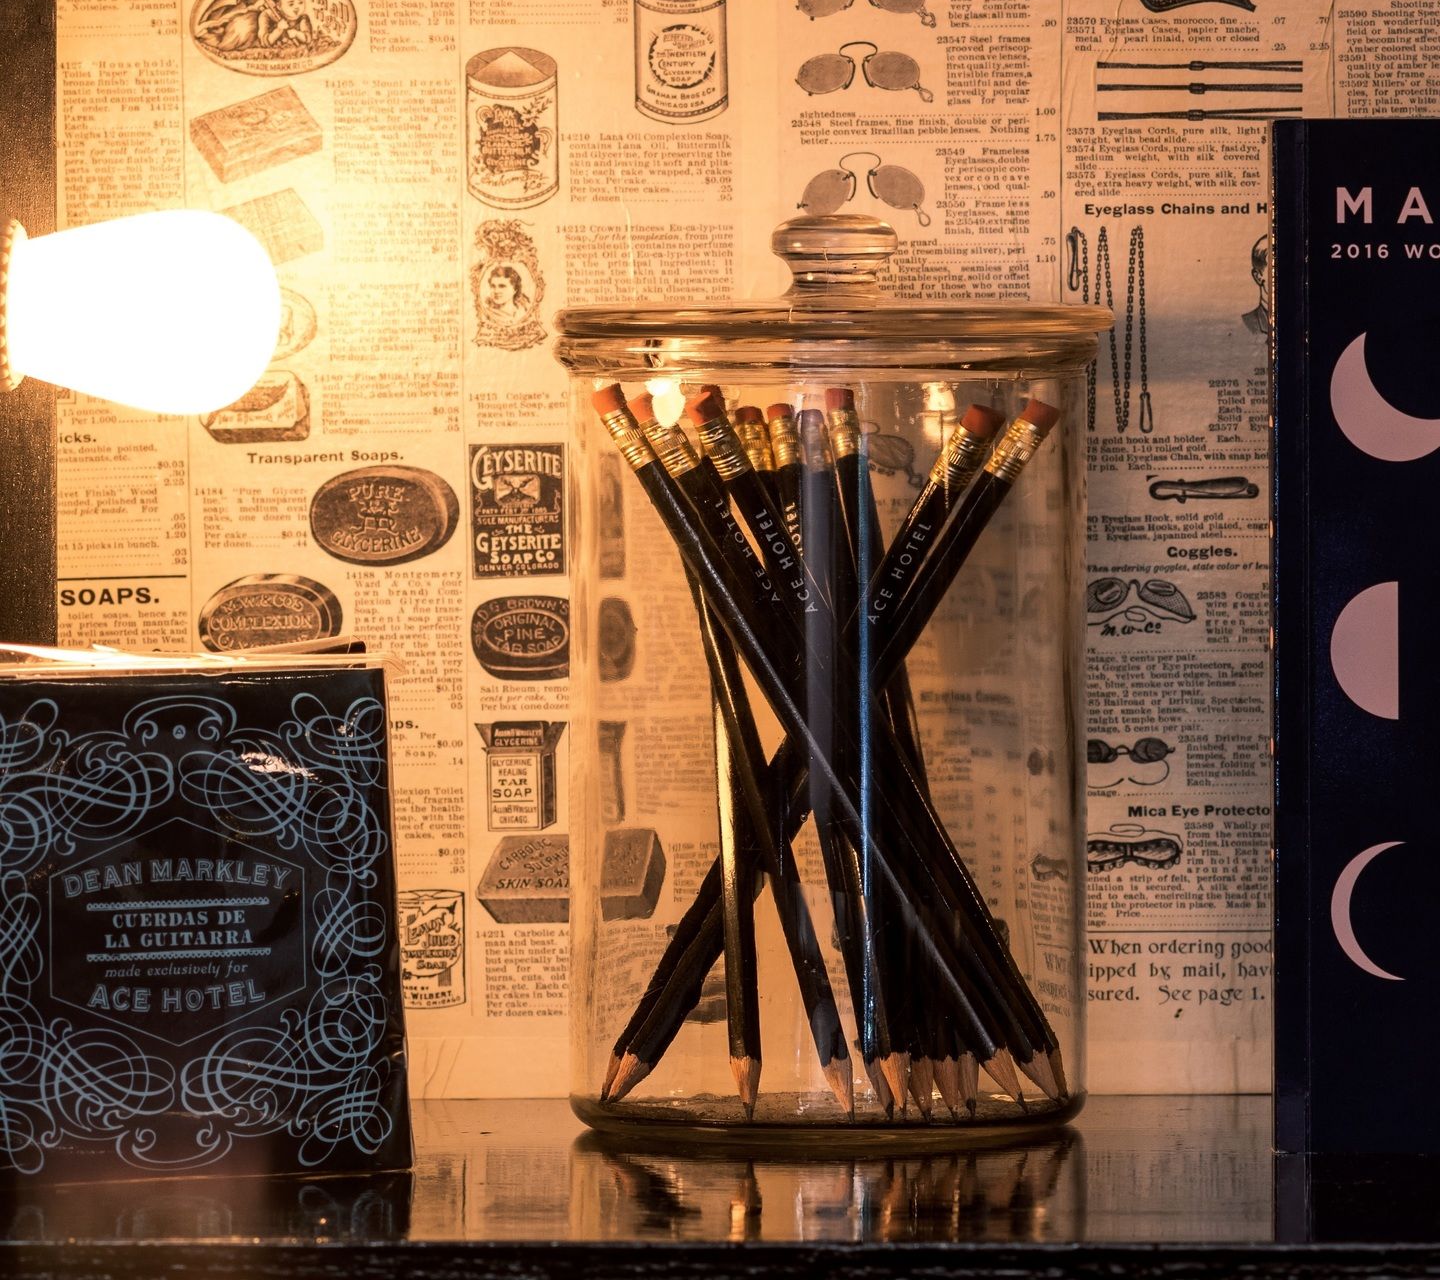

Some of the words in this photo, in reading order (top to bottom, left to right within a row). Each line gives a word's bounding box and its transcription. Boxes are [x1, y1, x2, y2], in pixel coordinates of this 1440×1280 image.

[1330, 243, 1391, 260] 2016
[246, 451, 344, 466] Transparent
[351, 450, 404, 463] Soaps.
[472, 446, 562, 490] GEYSERITE
[476, 532, 561, 553] GEYSERITE
[755, 508, 794, 570] HOTEL
[891, 524, 931, 579] HOTEL
[1166, 545, 1238, 561] Goggles.
[60, 587, 160, 607] SOAPS.
[791, 579, 818, 613] ACE
[867, 590, 893, 624] ACE
[64, 861, 143, 898] DEAN
[150, 858, 293, 890] MARKLEY
[112, 910, 208, 928] CUERDAS
[216, 908, 246, 925] DE
[104, 932, 134, 948] LA
[140, 928, 254, 947] GUITARRA
[104, 964, 142, 978] made
[147, 962, 220, 979] exclusively
[226, 960, 249, 978] for
[86, 984, 151, 1012] ACE
[160, 980, 266, 1013] HOTEL
